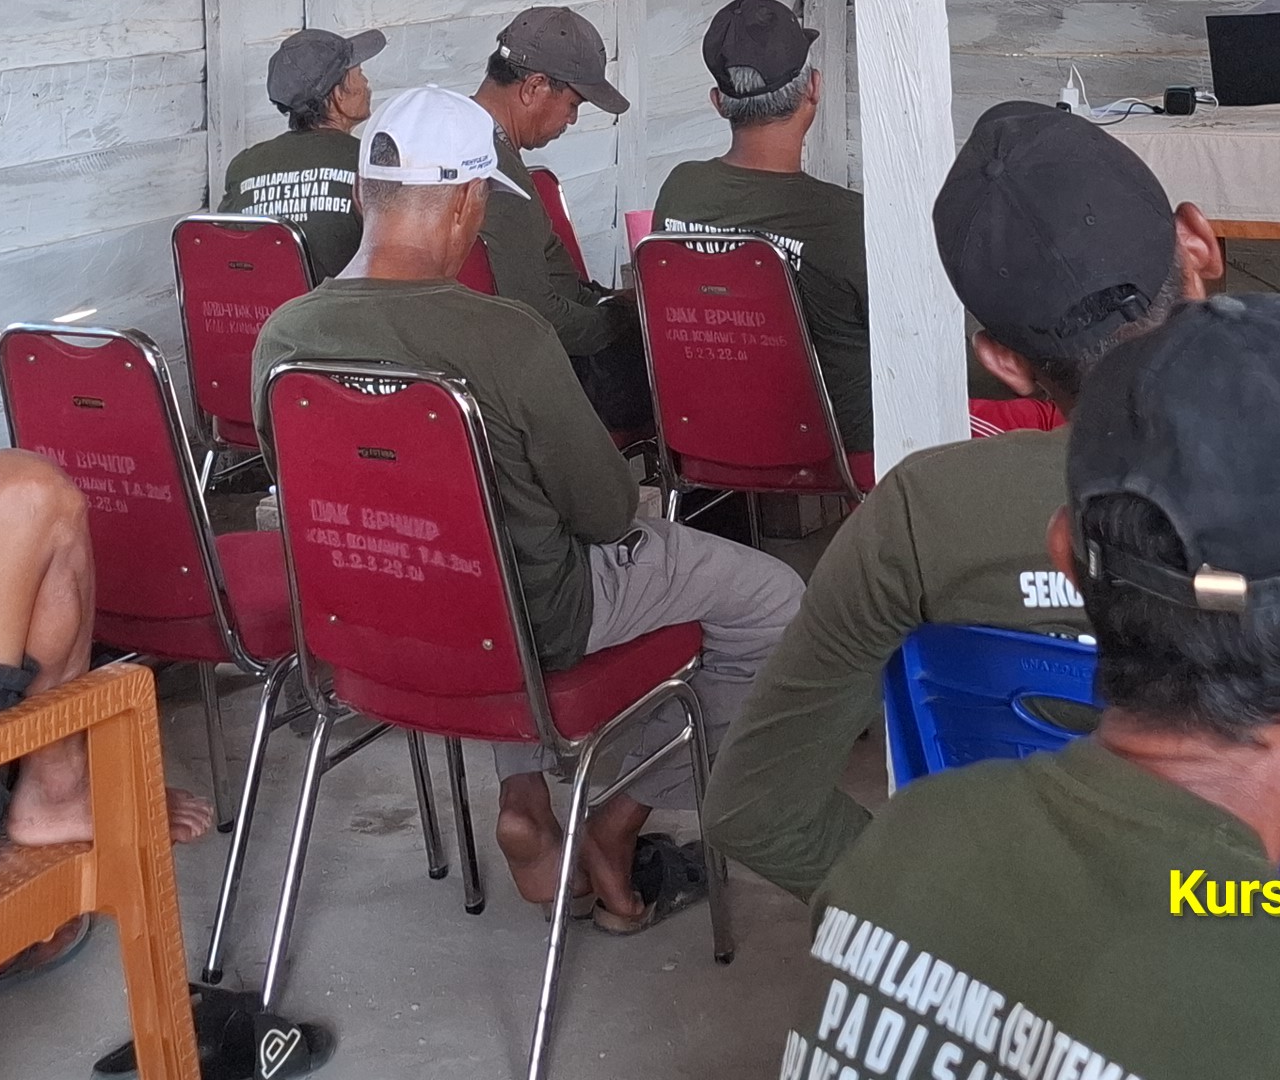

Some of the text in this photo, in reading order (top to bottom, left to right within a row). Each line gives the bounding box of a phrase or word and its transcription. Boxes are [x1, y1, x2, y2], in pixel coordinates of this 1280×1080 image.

[266, 171, 300, 187] LAPANG
[300, 168, 319, 183] (SL)
[253, 181, 330, 204] PADI SAWAH
[310, 196, 352, 214] MOROSI
[1019, 570, 1086, 608] SEKO
[878, 939, 1006, 1054] LAPANG
